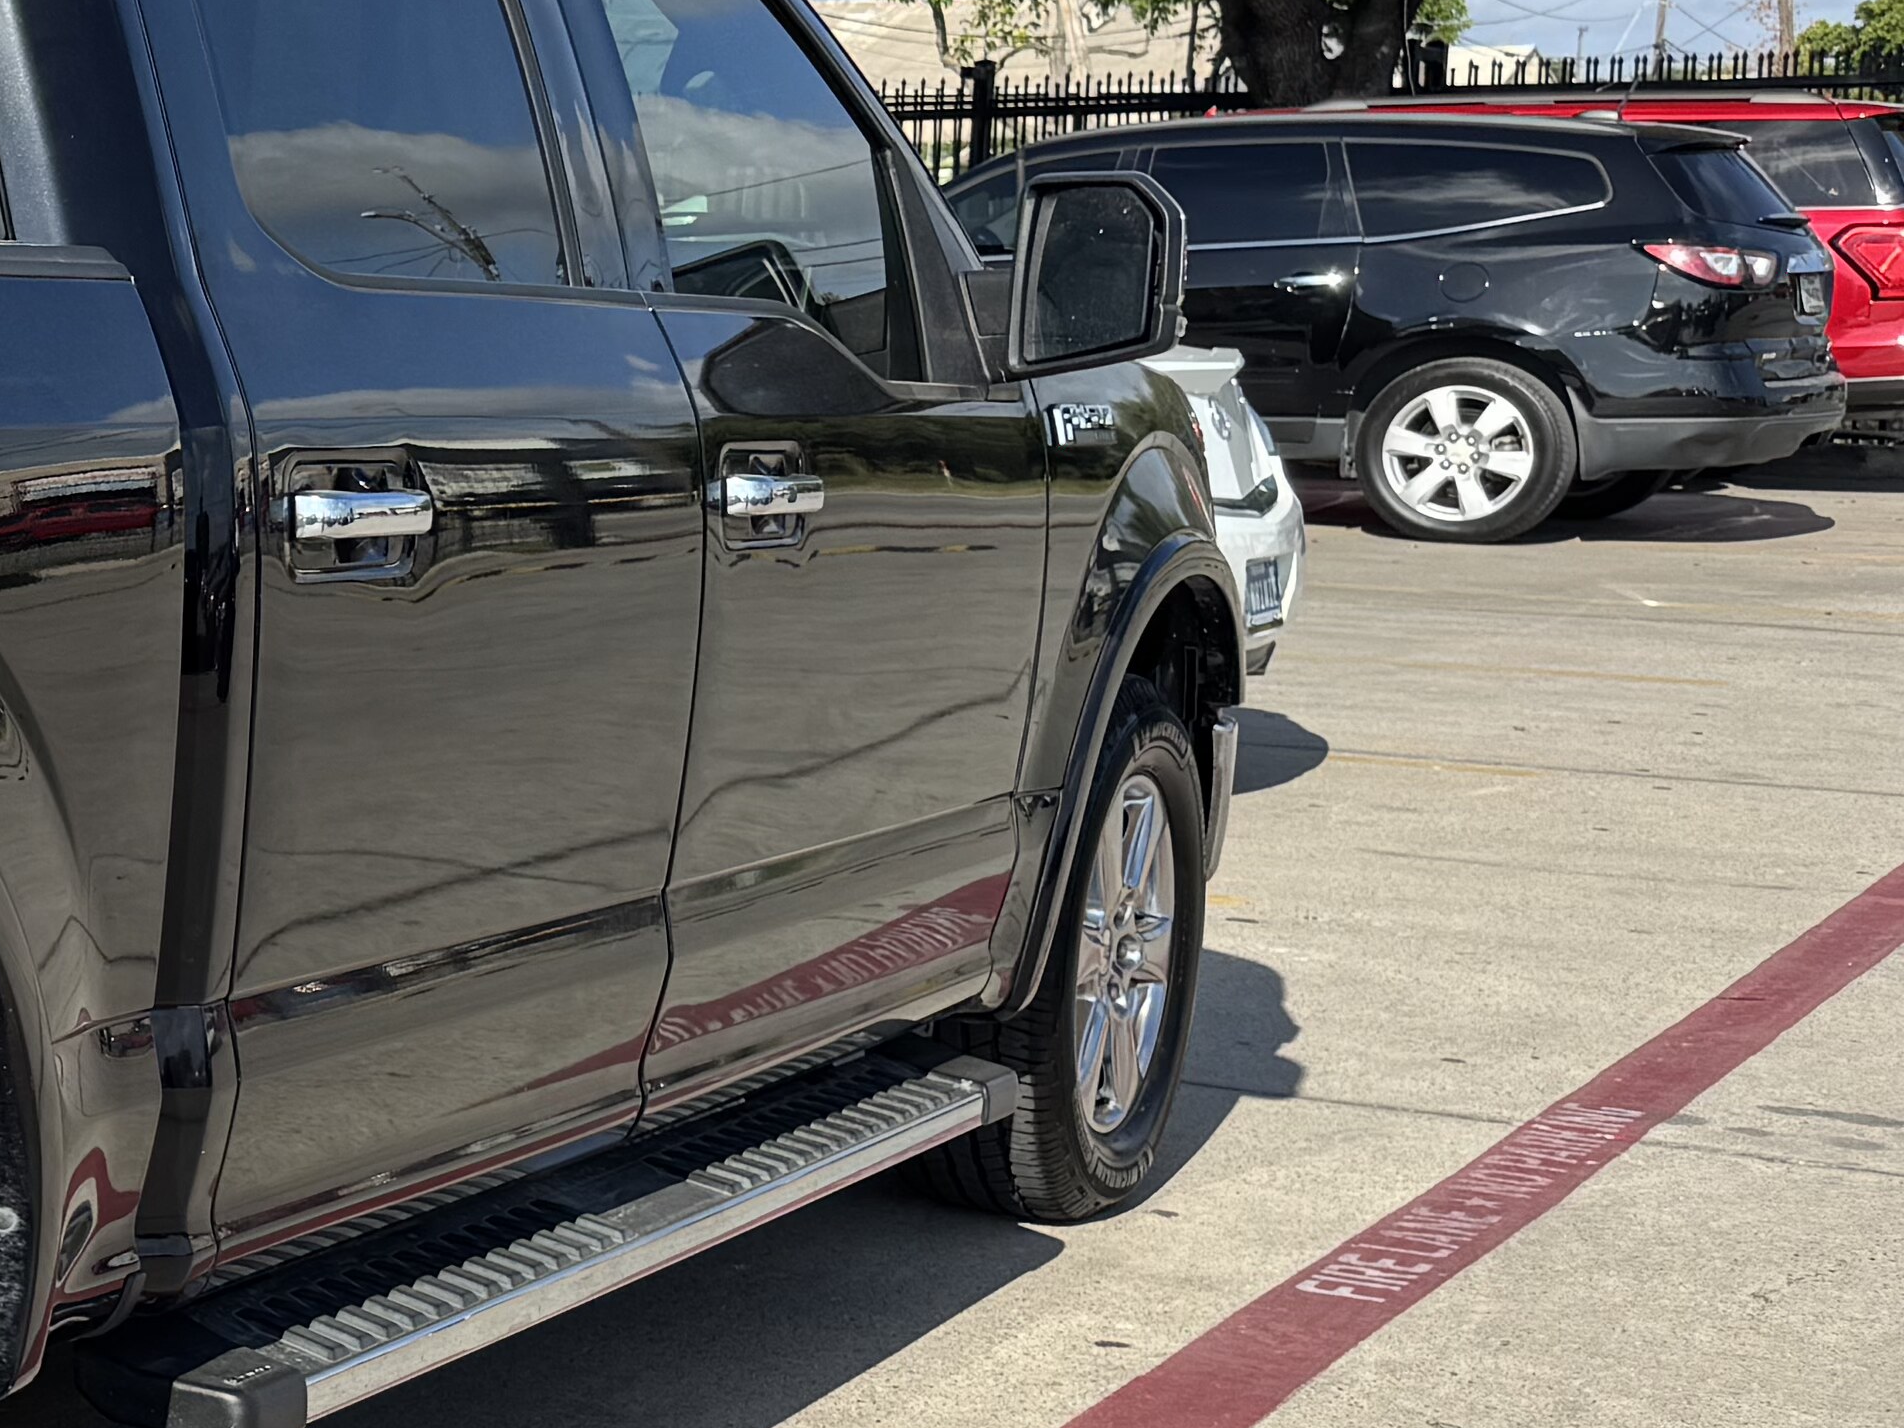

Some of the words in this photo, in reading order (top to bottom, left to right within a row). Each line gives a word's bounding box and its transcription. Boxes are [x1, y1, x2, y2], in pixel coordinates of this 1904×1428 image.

[1481, 1102, 1646, 1173] PARKING
[1447, 1169, 1555, 1199] NO
[1351, 1206, 1502, 1259] LANE
[1295, 1253, 1435, 1303] FIRE
